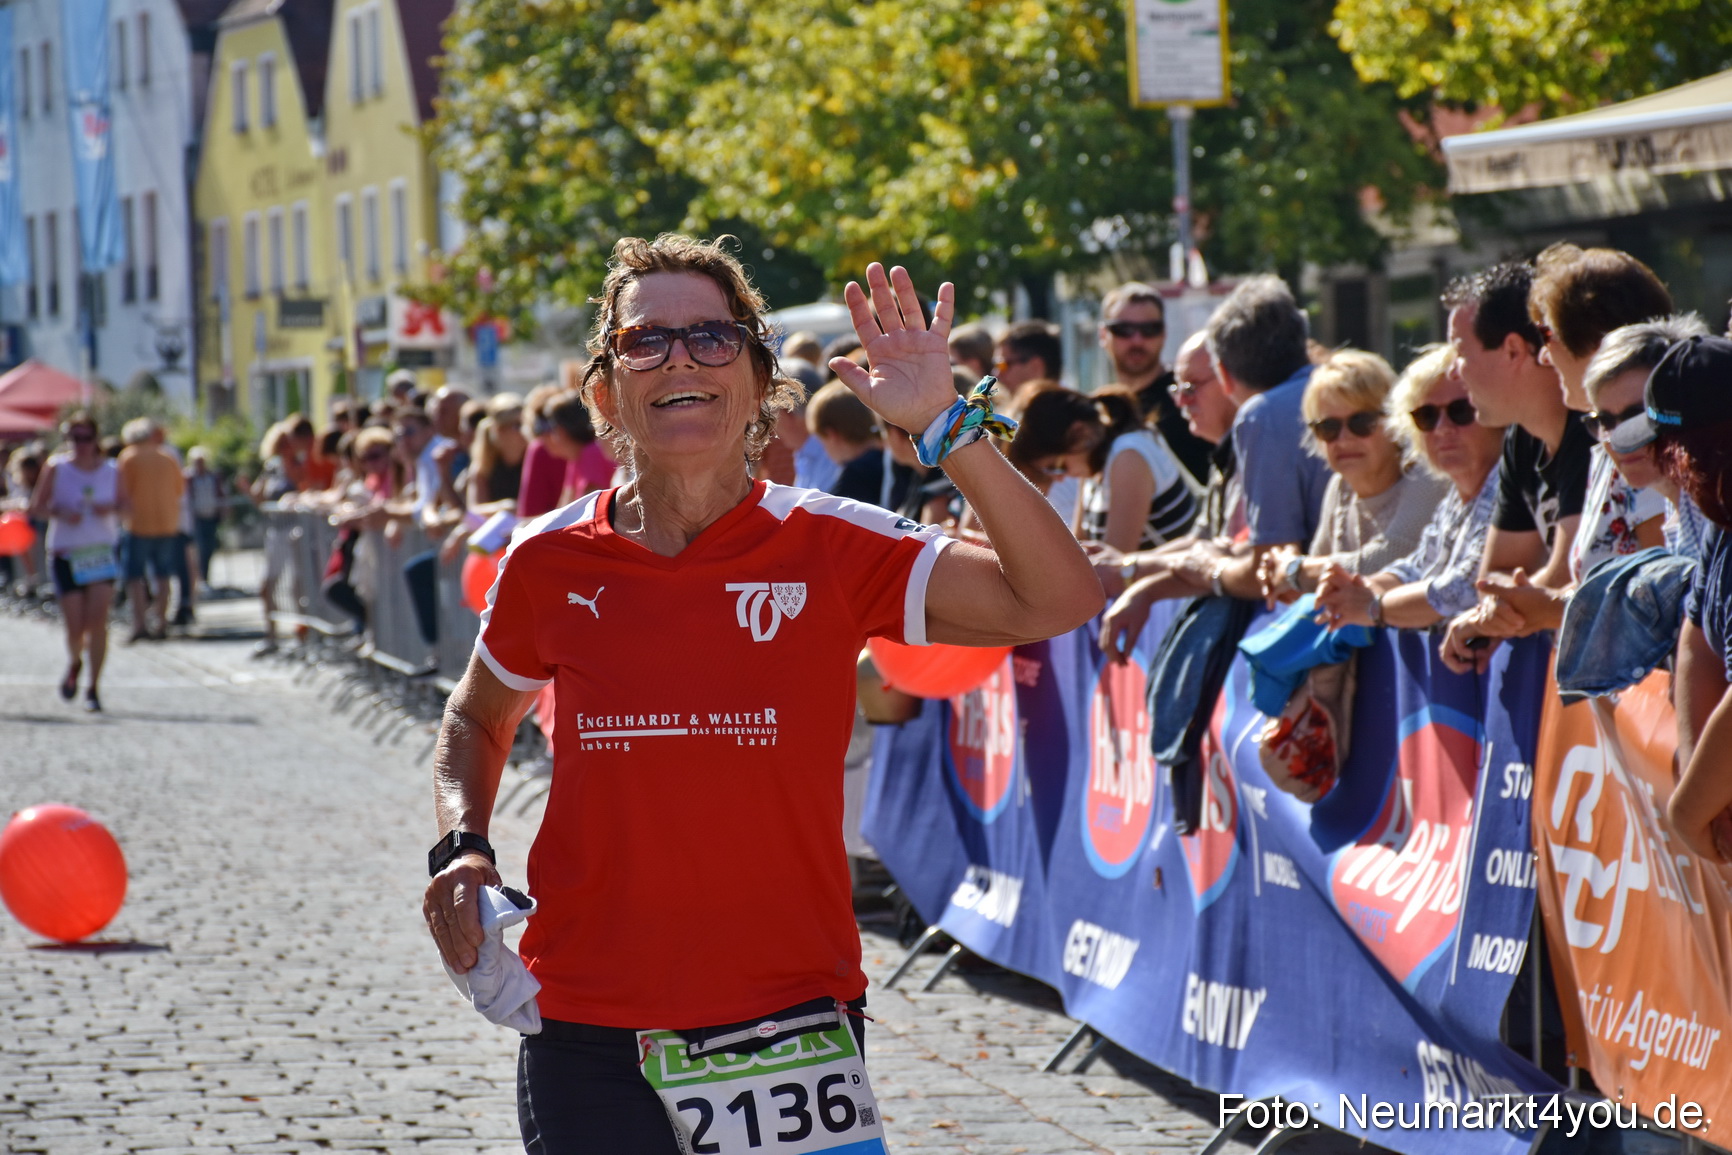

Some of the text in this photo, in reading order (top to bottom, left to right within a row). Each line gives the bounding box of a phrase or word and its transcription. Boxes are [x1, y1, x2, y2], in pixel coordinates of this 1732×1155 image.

[577, 708, 777, 730] ENGELHARDT & WALTER
[580, 736, 777, 752] Amberg Lauf
[676, 1073, 857, 1154] 2136
[851, 1074, 861, 1085] D
